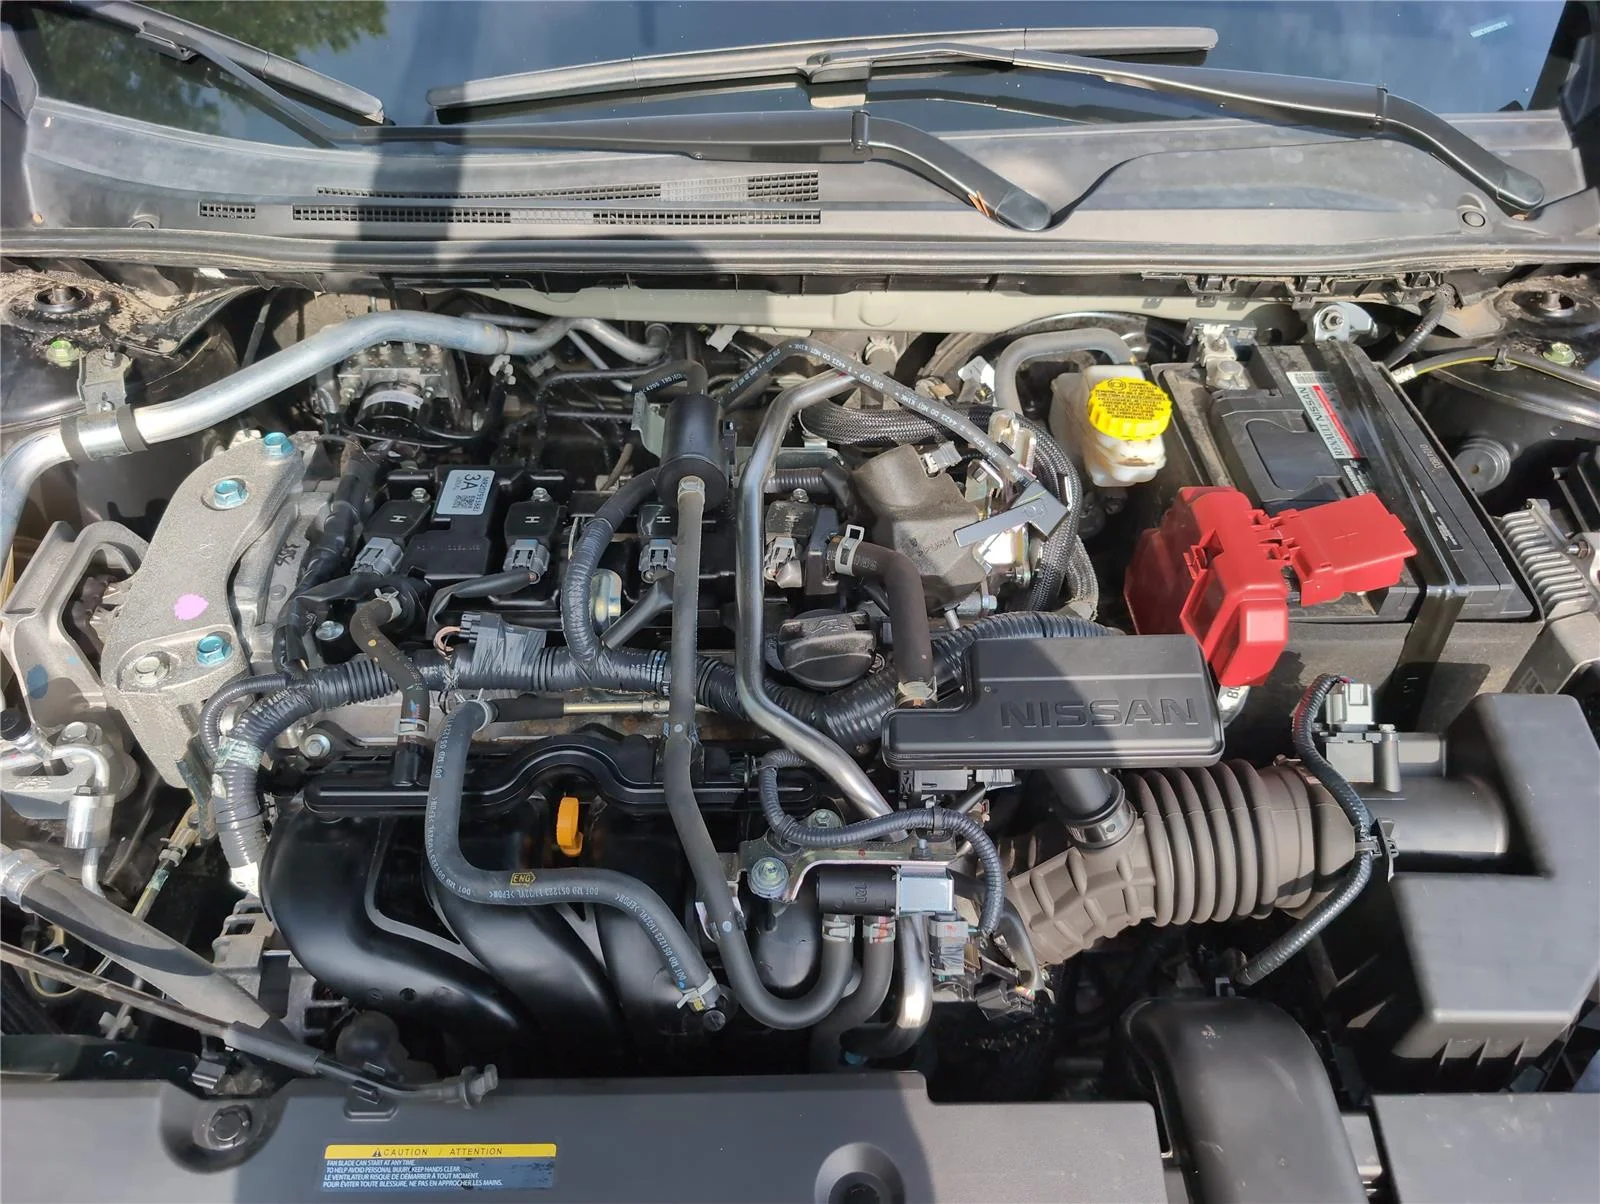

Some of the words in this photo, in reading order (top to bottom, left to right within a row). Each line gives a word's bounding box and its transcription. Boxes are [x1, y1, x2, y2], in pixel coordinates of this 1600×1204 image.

[1297, 387, 1323, 422] NISSAN
[1318, 421, 1345, 457] RENAULT
[460, 473, 482, 491] 3A
[1001, 698, 1199, 728] NISSAN
[513, 873, 532, 884] ENG
[654, 931, 672, 956] 051223
[383, 1148, 428, 1156] CAUTION
[450, 1147, 503, 1155] ATTENTION
